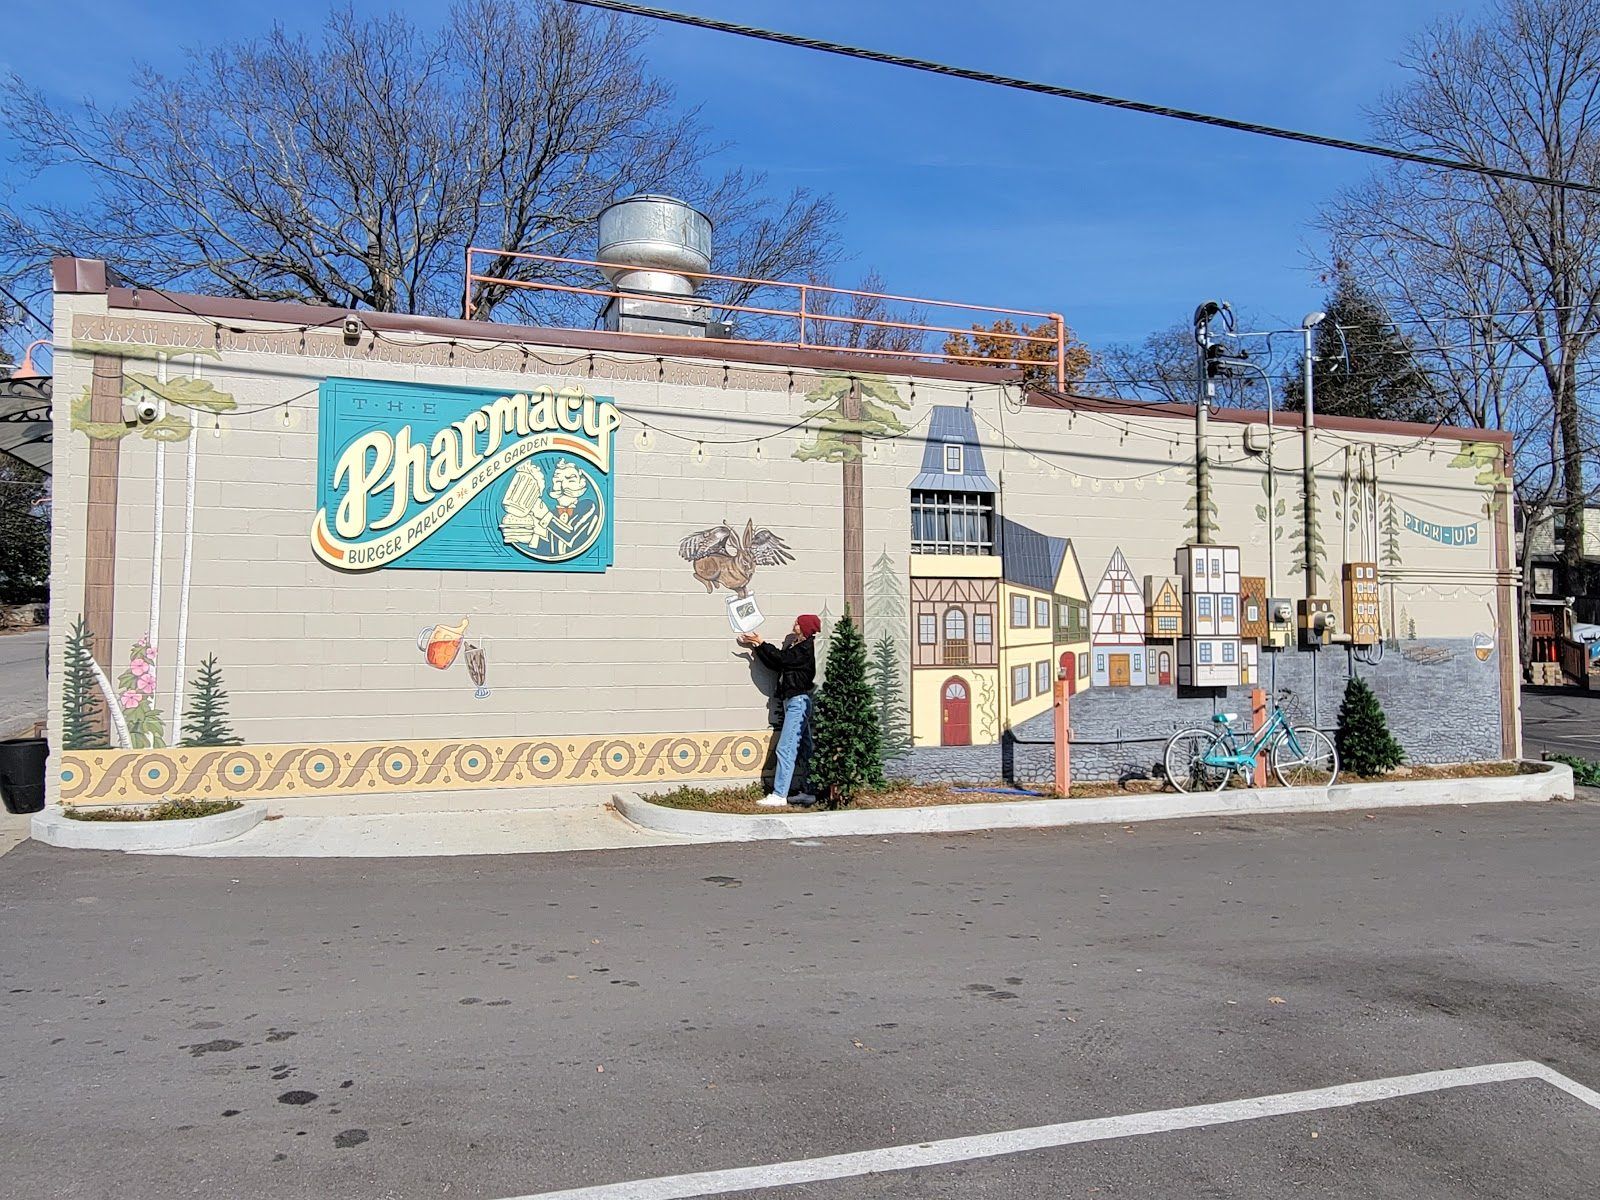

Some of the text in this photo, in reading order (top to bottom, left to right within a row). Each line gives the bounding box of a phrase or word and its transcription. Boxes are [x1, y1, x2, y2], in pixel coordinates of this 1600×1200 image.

[348, 436, 549, 564] BURGER PARLOR BEER GARDEN
[1405, 514, 1476, 542] PICK-UP
